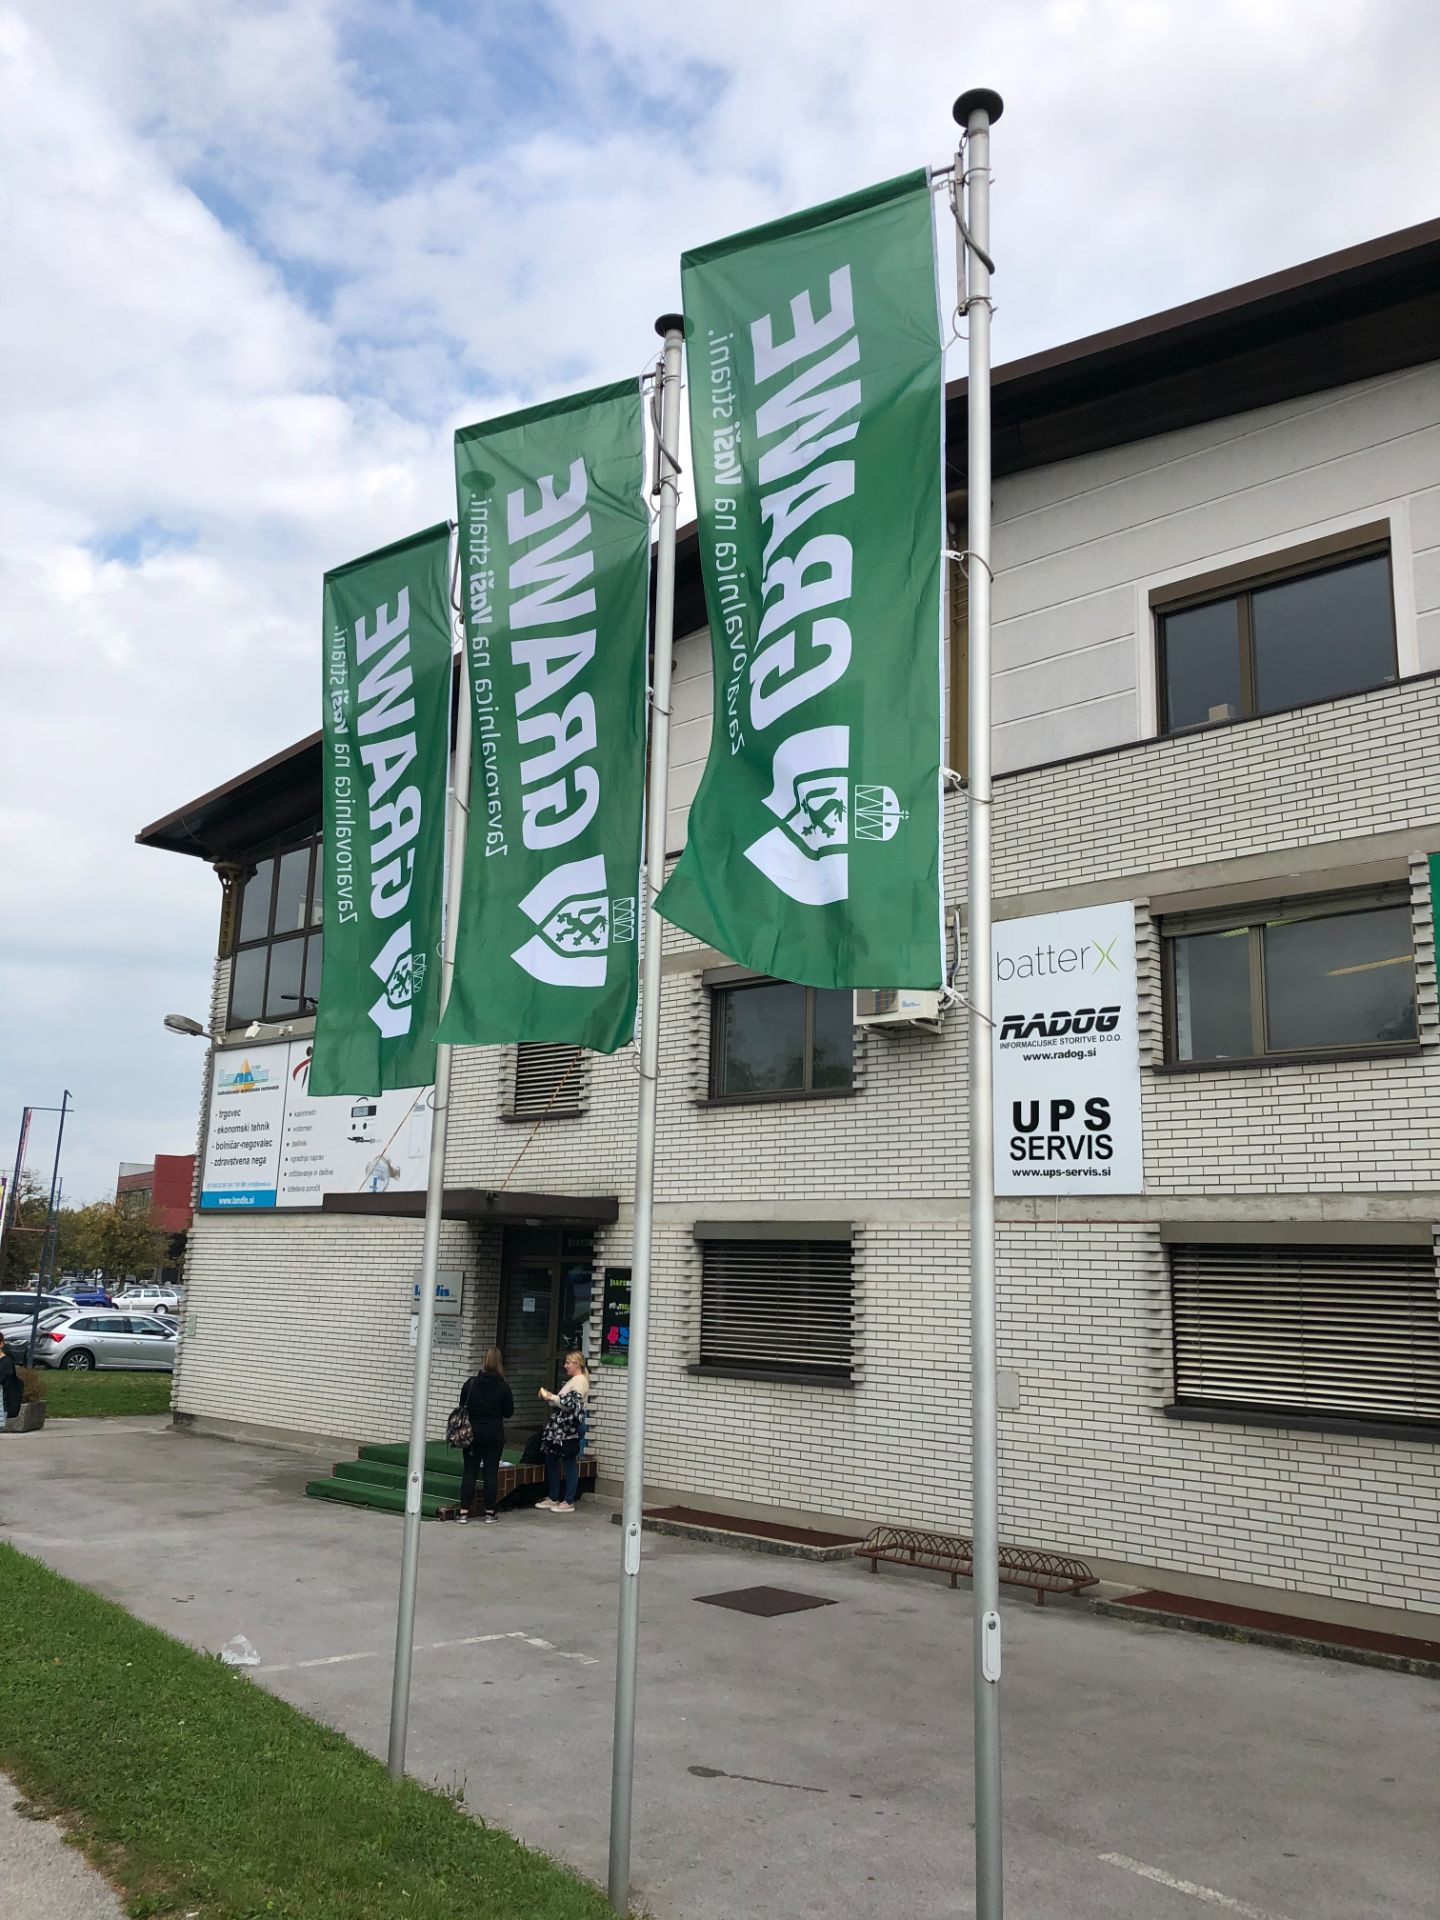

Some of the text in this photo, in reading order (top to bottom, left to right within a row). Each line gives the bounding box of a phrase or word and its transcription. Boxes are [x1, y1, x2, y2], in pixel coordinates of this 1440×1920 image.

[996, 936, 1120, 981] batterX
[1000, 1006, 1121, 1040] RADOG
[1000, 1033, 1122, 1050] INFORMACIJSKE STORITVE D.O.O.
[1023, 1048, 1097, 1061] www.radog.si
[219, 1109, 241, 1120] trgovec
[1013, 1097, 1111, 1133] UPS
[217, 1121, 270, 1134] ekonomski tehnik
[215, 1138, 273, 1150] bolničar-negovalec
[1010, 1134, 1113, 1161] SERVIS
[214, 1156, 267, 1166] zdravstvena nega
[1012, 1166, 1111, 1178] www.ups-servis.si
